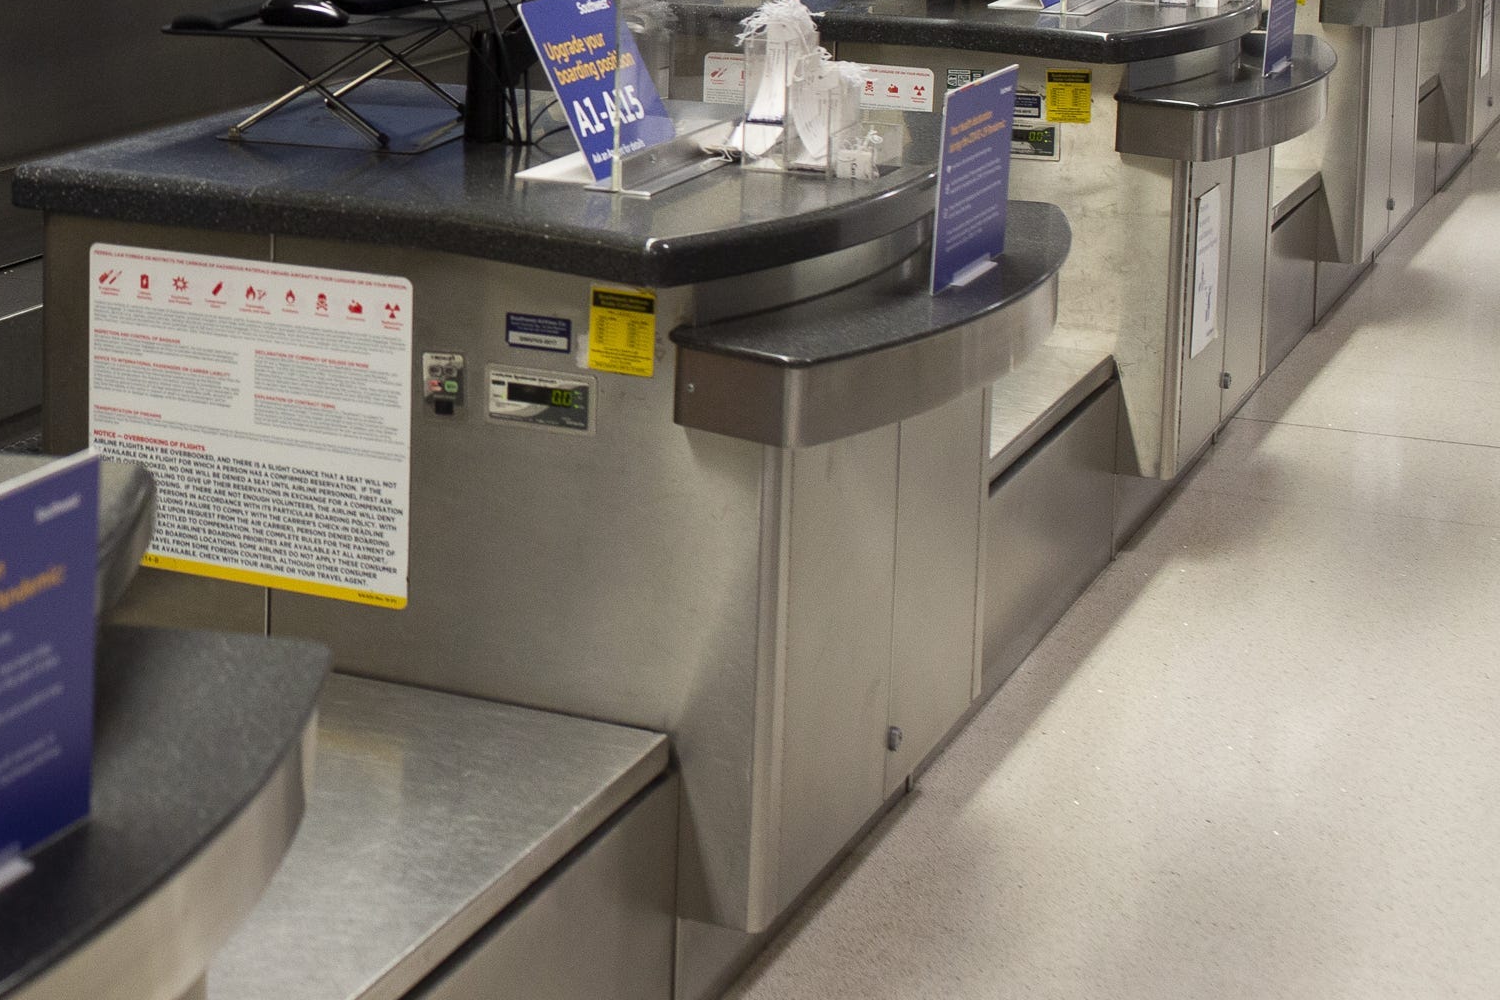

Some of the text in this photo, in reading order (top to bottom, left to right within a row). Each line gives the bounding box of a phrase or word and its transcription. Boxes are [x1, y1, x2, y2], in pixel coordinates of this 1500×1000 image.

[543, 33, 605, 64] Upgrade your
[553, 60, 600, 86] boarding
[573, 85, 645, 138] A1-A15
[93, 429, 205, 452] NOTICE OVERBOOKING OF FLIGHTS
[93, 437, 117, 447] AIRLINE
[118, 441, 143, 451] FLIGHTS
[144, 445, 158, 453] MAY
[217, 455, 230, 464] AND
[232, 458, 252, 467] THERE
[267, 463, 289, 473] SLIGHT
[291, 467, 318, 477] CHANCE
[320, 471, 337, 480] THAT
[346, 475, 362, 484] SEAT
[364, 477, 380, 486] WILL
[382, 480, 396, 489] NOT
[102, 446, 136, 458] AVAILABLE
[155, 454, 176, 464] FLIGHT
[178, 458, 191, 466] FOR
[193, 460, 214, 470] WHICH
[222, 464, 247, 475] PERSON
[249, 468, 262, 477] HAS
[269, 472, 308, 484] CONFIRMED
[369, 487, 381, 495] THE
[180, 466, 193, 475] ONE
[195, 469, 209, 477] WILL
[221, 473, 245, 483] DENIED
[253, 478, 269, 486] SEAT
[270, 480, 289, 489] UNTIL
[291, 483, 316, 494] AIRLINE
[318, 487, 356, 500] PERSONNEL
[359, 493, 377, 503] FIRST
[379, 497, 392, 505] ASK
[186, 476, 201, 484] GIVE
[213, 480, 231, 489] THEIR
[290, 492, 326, 504] EXCHANGE
[328, 497, 341, 506] FOR
[192, 485, 211, 494] THERE
[213, 488, 226, 496] ARE
[227, 490, 240, 499] NOT
[242, 492, 270, 503] ENOUGH
[317, 504, 329, 512] THE
[331, 506, 357, 517] AIRLINE
[358, 511, 374, 520] WILL
[376, 513, 394, 523] DENY
[158, 487, 187, 498] PERSONS
[243, 501, 260, 510] WITH
[261, 504, 271, 512] ITS
[314, 512, 349, 524] BOARDING
[378, 522, 396, 532] WITH
[167, 505, 185, 515] UPON
[186, 508, 215, 519] REQUEST
[216, 513, 235, 523] FROM
[236, 516, 248, 525] THE
[250, 519, 261, 527] AIR
[296, 526, 326, 537] PERSONS
[327, 531, 352, 542] DENIED
[353, 535, 389, 548] BOARDING
[184, 500, 384, 538] FAILURE COMPLY WITH THE CARRIER'S CHECK-IN DEADLINE
[156, 520, 175, 529] EACH
[176, 523, 206, 534] AIRLINE'S
[207, 528, 241, 540] BOARDING
[279, 540, 291, 548] ARE
[293, 542, 330, 555] AVAILABLE
[342, 550, 353, 558] ALL
[356, 552, 384, 564] AIRPORT
[164, 529, 198, 541] BOARDING
[238, 542, 256, 551] SOME
[258, 545, 286, 556] AIRLINES
[299, 552, 313, 560] NOT
[315, 554, 335, 564] APPLY
[338, 558, 358, 568] THESE
[359, 561, 397, 574] CONSUMER
[172, 539, 190, 548] FROM
[191, 542, 209, 551] SOME
[210, 545, 238, 556] FOREIGN
[279, 557, 315, 569] ALTHOUGH
[316, 563, 338, 573] OTHER
[339, 567, 377, 579] CONSUMER
[252, 527, 264, 536] THE
[265, 529, 299, 541] COMPLETE
[300, 535, 321, 545] RULES
[323, 539, 337, 547] FOR
[338, 541, 351, 550] THE
[352, 543, 383, 555] PAYMENT
[199, 551, 220, 561] CHECK
[221, 555, 238, 564] WITH
[240, 558, 258, 568] YOUR
[259, 561, 284, 572] AIRLINE
[297, 568, 315, 577] YOUR
[317, 571, 341, 582] TRAVEL
